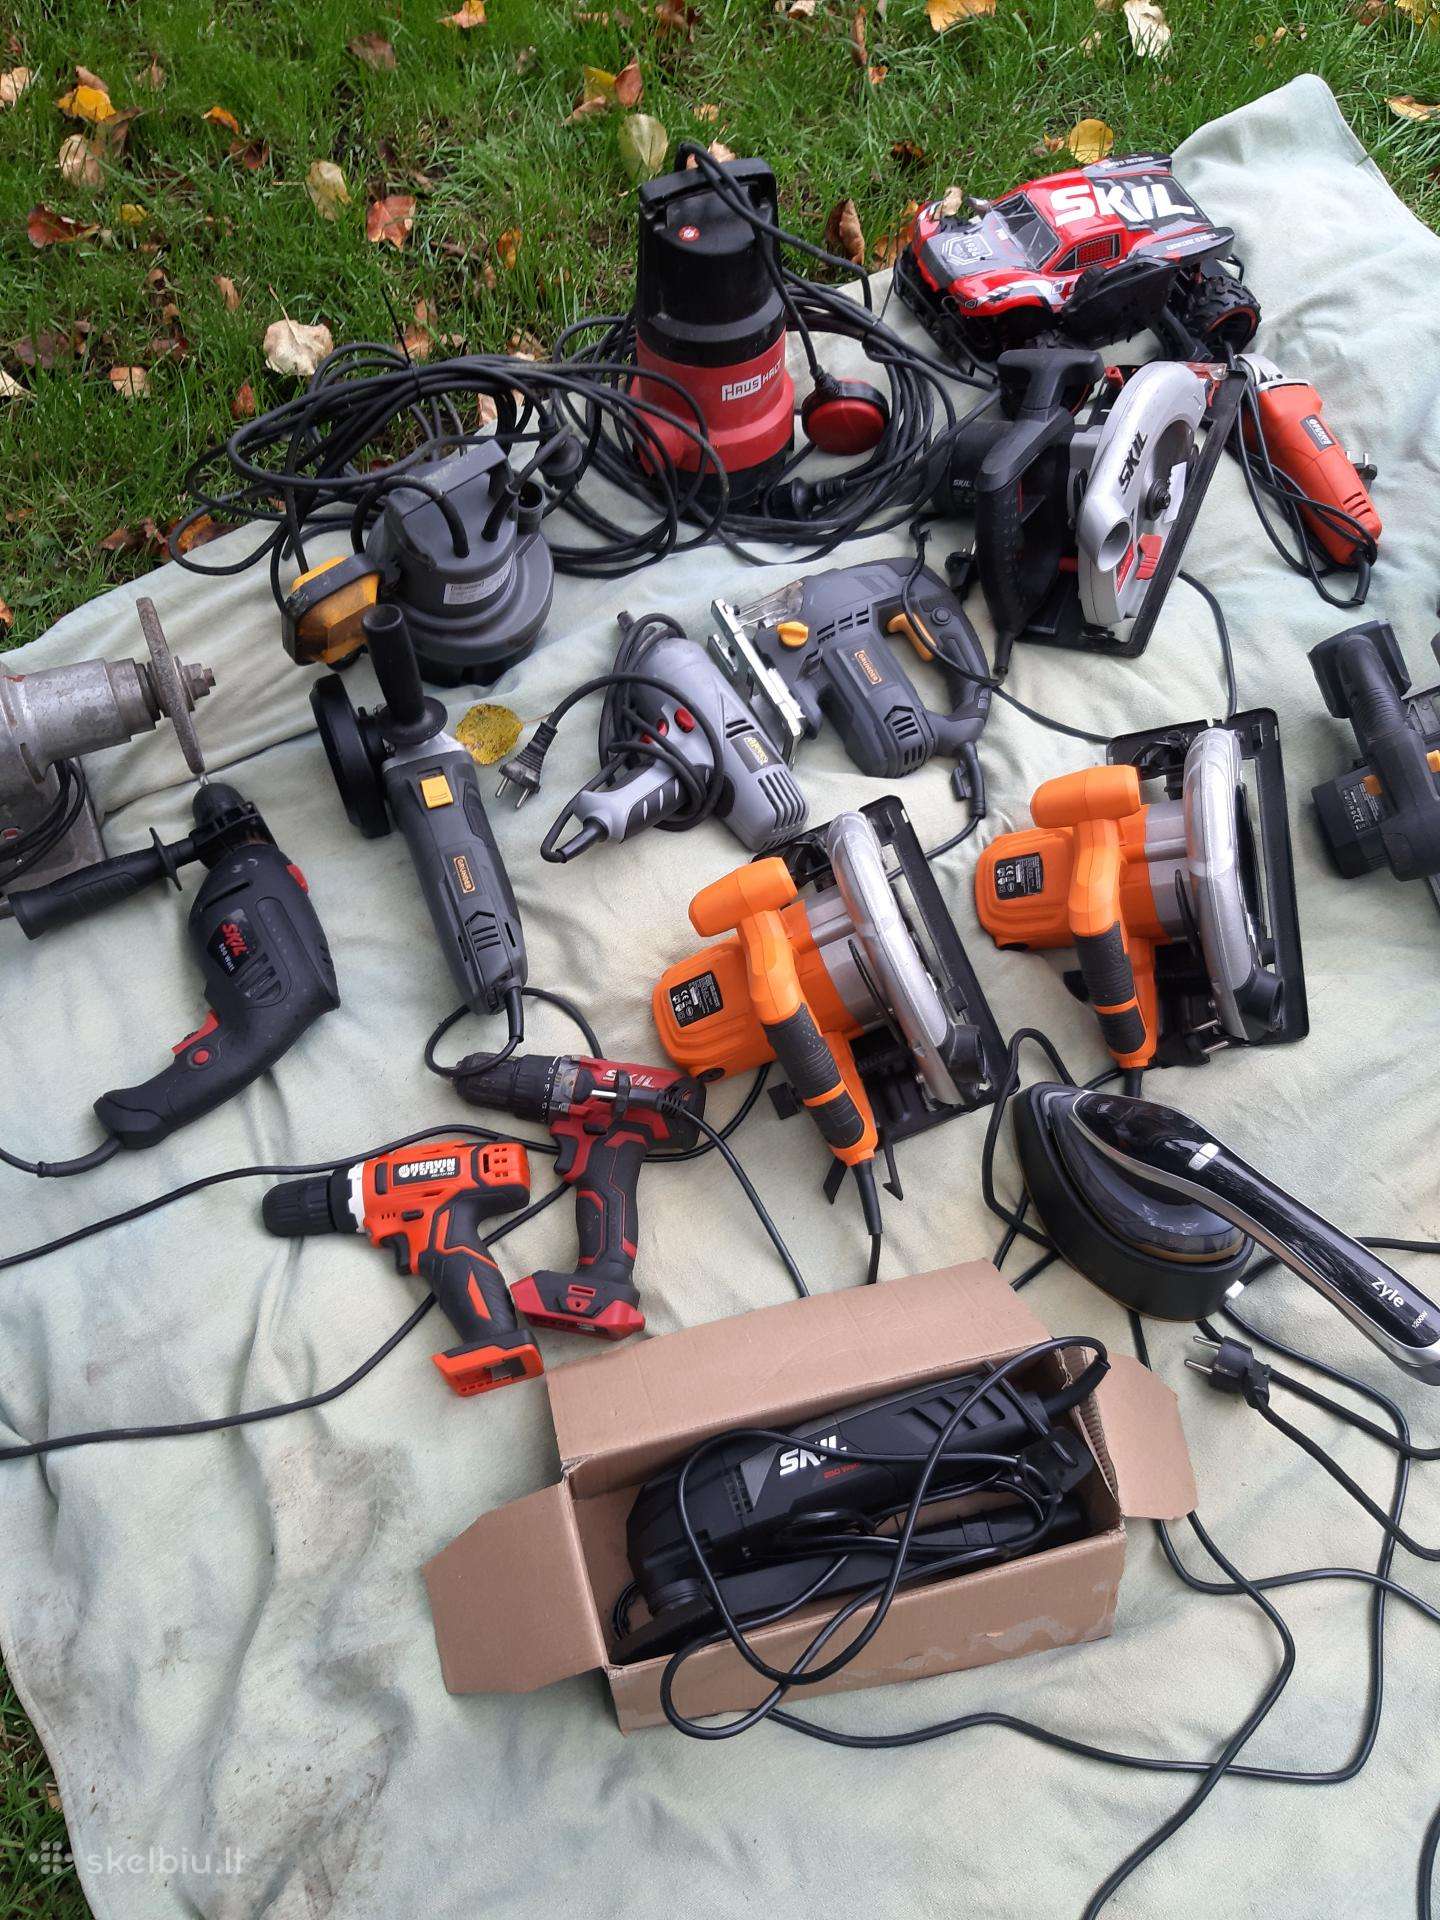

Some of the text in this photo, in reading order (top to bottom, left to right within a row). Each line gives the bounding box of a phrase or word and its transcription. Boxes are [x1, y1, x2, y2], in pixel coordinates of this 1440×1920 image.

[1050, 184, 1196, 227] SKIL
[1119, 430, 1148, 495] SKIL
[222, 924, 248, 957] SKIL
[603, 1069, 655, 1088] SIL
[411, 1158, 456, 1172] HERVIN
[1371, 1277, 1404, 1307] zyle
